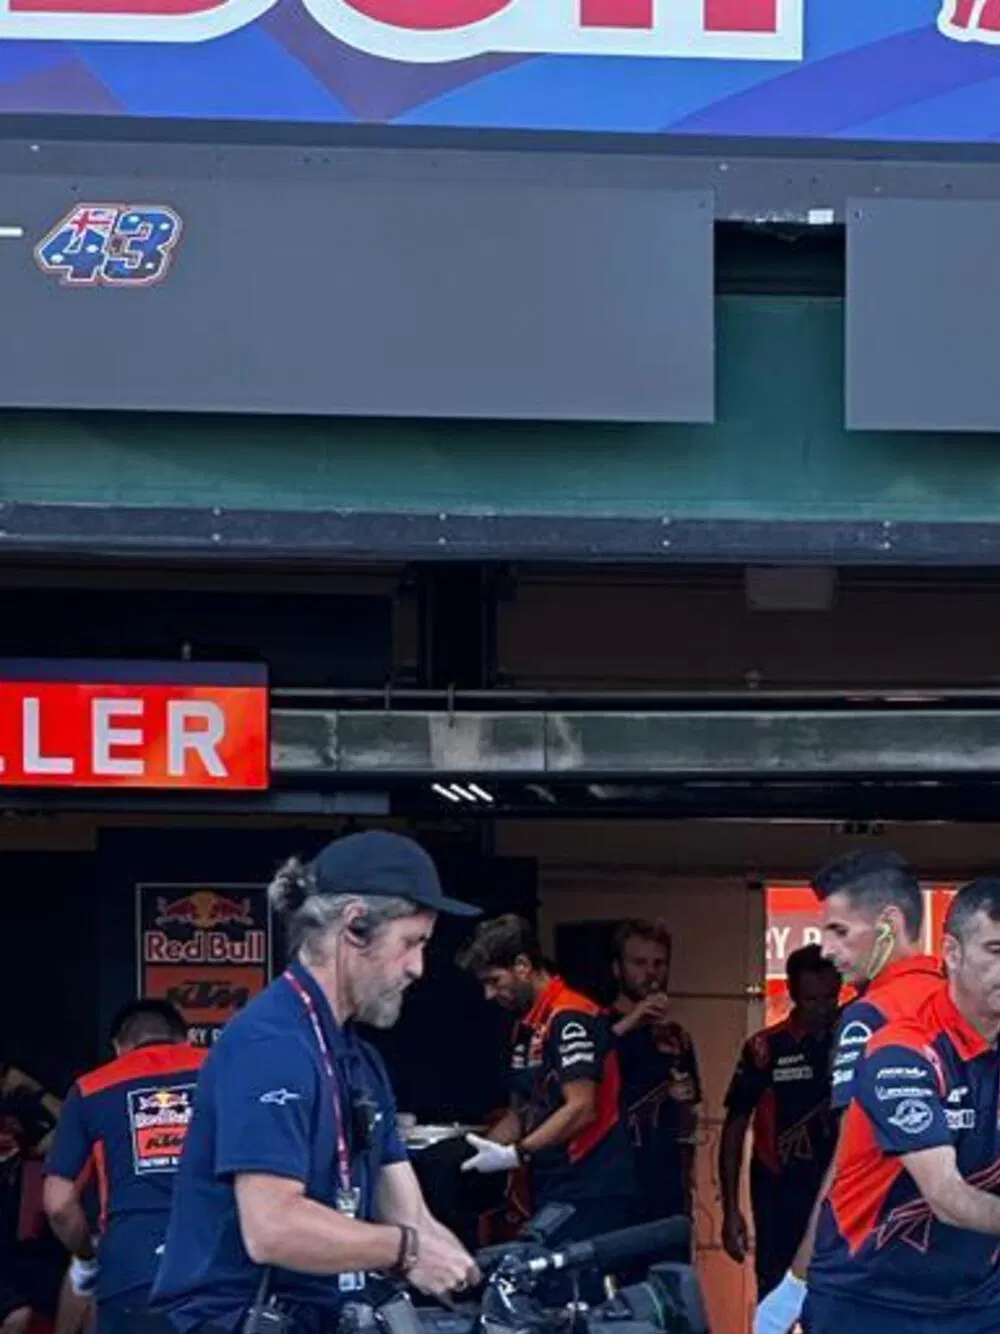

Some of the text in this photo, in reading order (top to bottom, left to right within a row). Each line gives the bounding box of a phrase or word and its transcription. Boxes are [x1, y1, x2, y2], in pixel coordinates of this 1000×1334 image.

[35, 202, 183, 286] 43
[0, 697, 229, 777] LER
[144, 930, 267, 963] Red Bull
